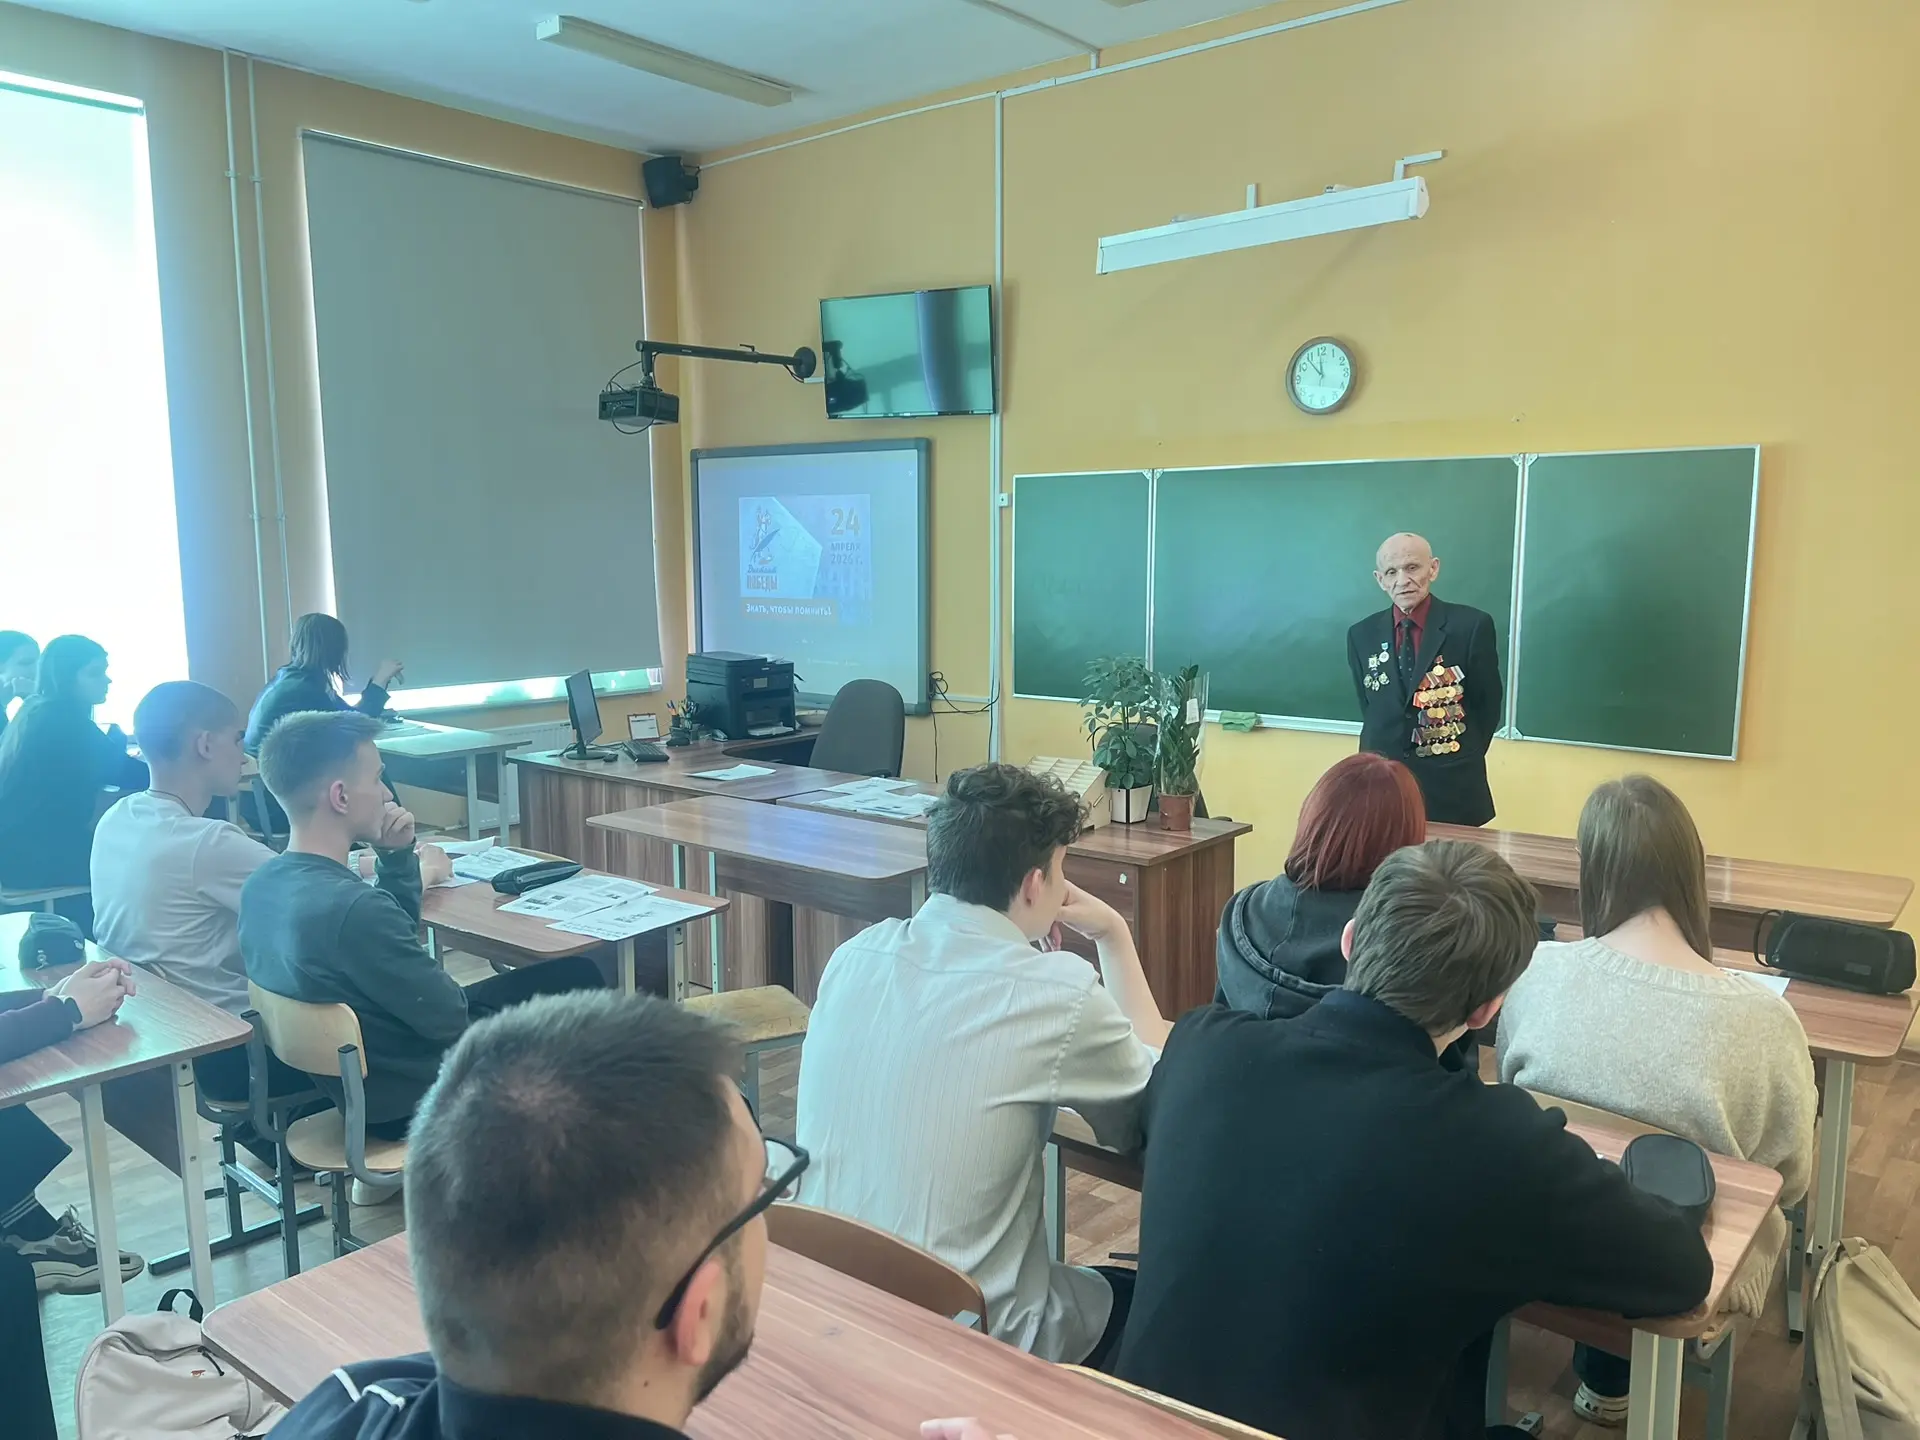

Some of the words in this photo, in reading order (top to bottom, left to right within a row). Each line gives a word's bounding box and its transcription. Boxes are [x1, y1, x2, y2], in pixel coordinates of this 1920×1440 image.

[1317, 346, 1327, 356] 12
[1306, 352, 1314, 362] 11
[1339, 356, 1345, 366] 2
[1299, 362, 1308, 373] 10
[1343, 367, 1349, 378] 3
[1295, 375, 1301, 385] 9
[831, 508, 860, 537] 24
[746, 603, 769, 615] Знать,
